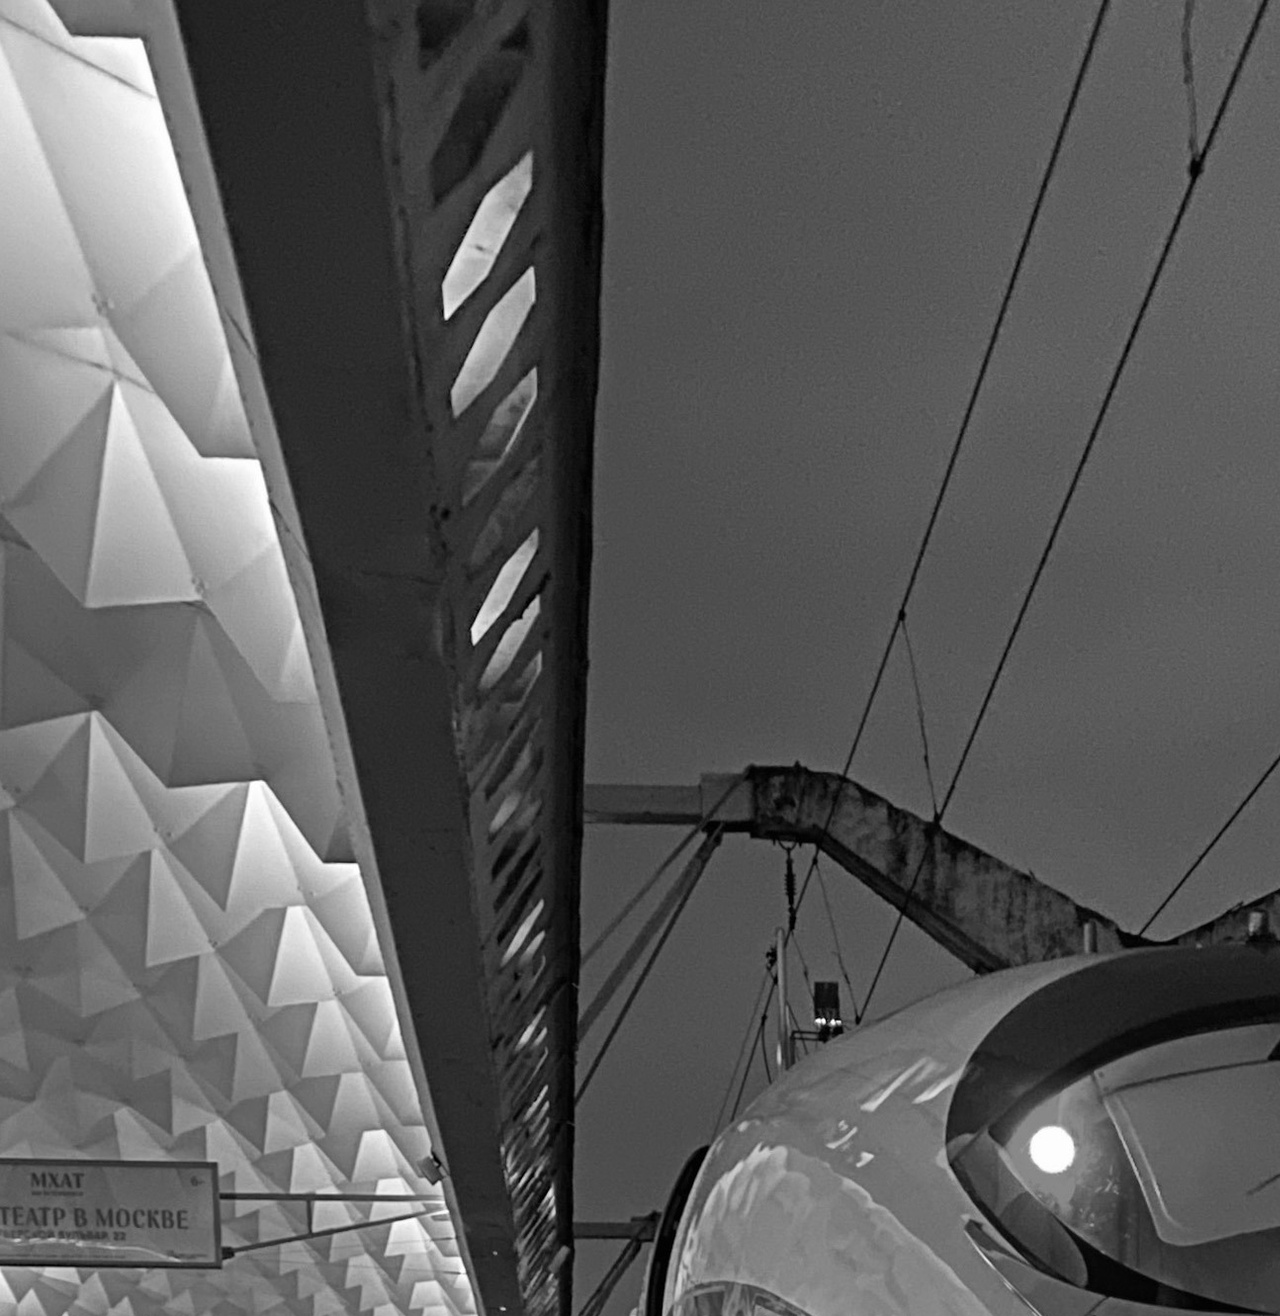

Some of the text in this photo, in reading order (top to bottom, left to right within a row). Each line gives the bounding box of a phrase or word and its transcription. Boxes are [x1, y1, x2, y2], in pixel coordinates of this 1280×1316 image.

[30, 1172, 84, 1189] МХАТ
[0, 1206, 190, 1230] ТЕАТР В МОСКВЕ
